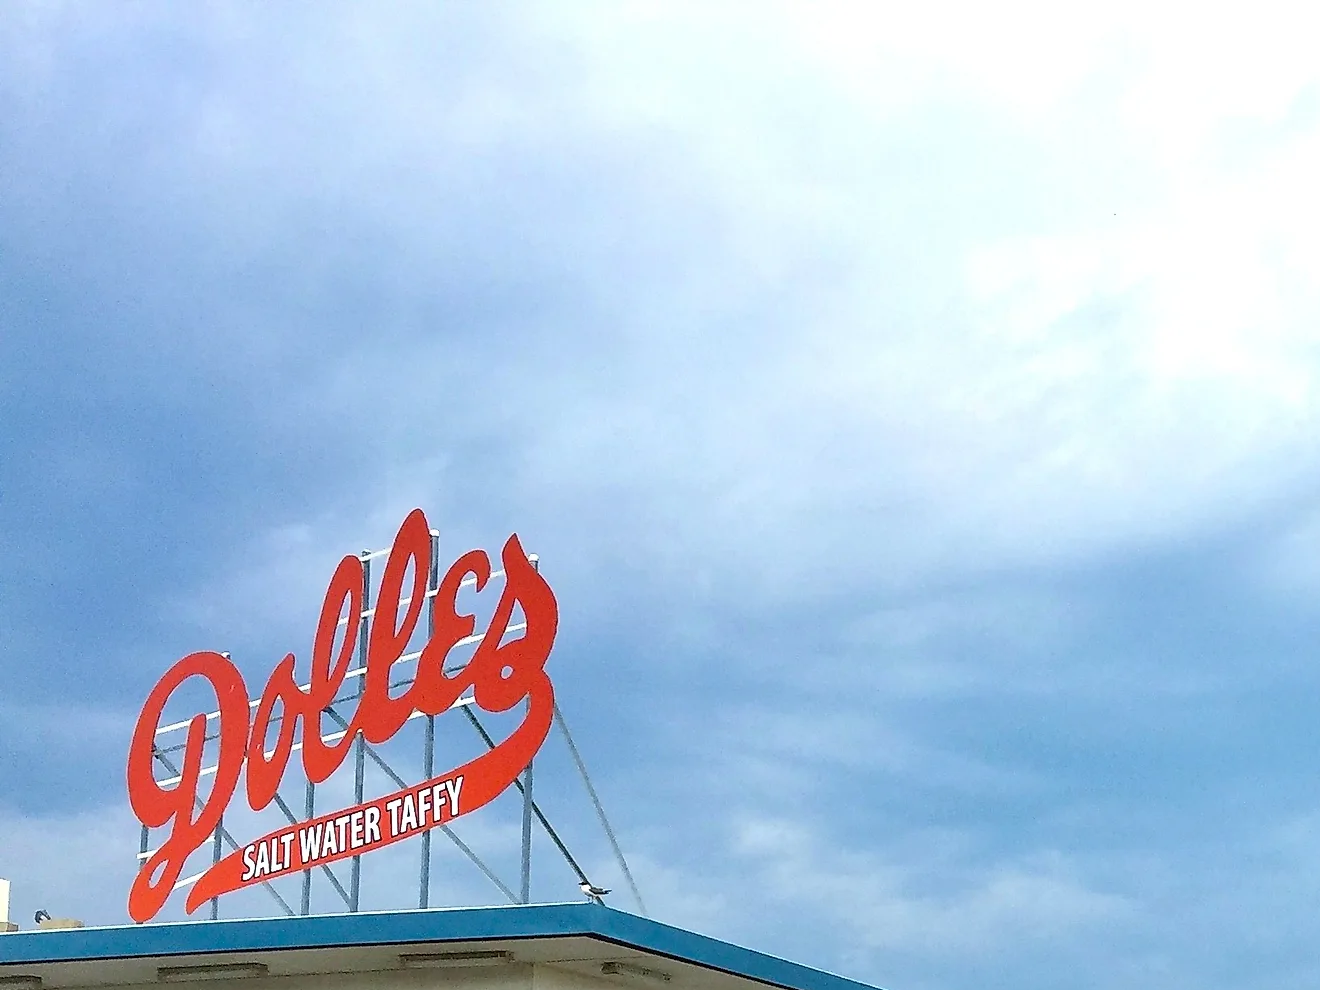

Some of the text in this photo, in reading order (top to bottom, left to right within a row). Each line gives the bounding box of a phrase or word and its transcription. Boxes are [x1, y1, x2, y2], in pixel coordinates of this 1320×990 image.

[242, 775, 464, 882] SALT WATER TAFFY
